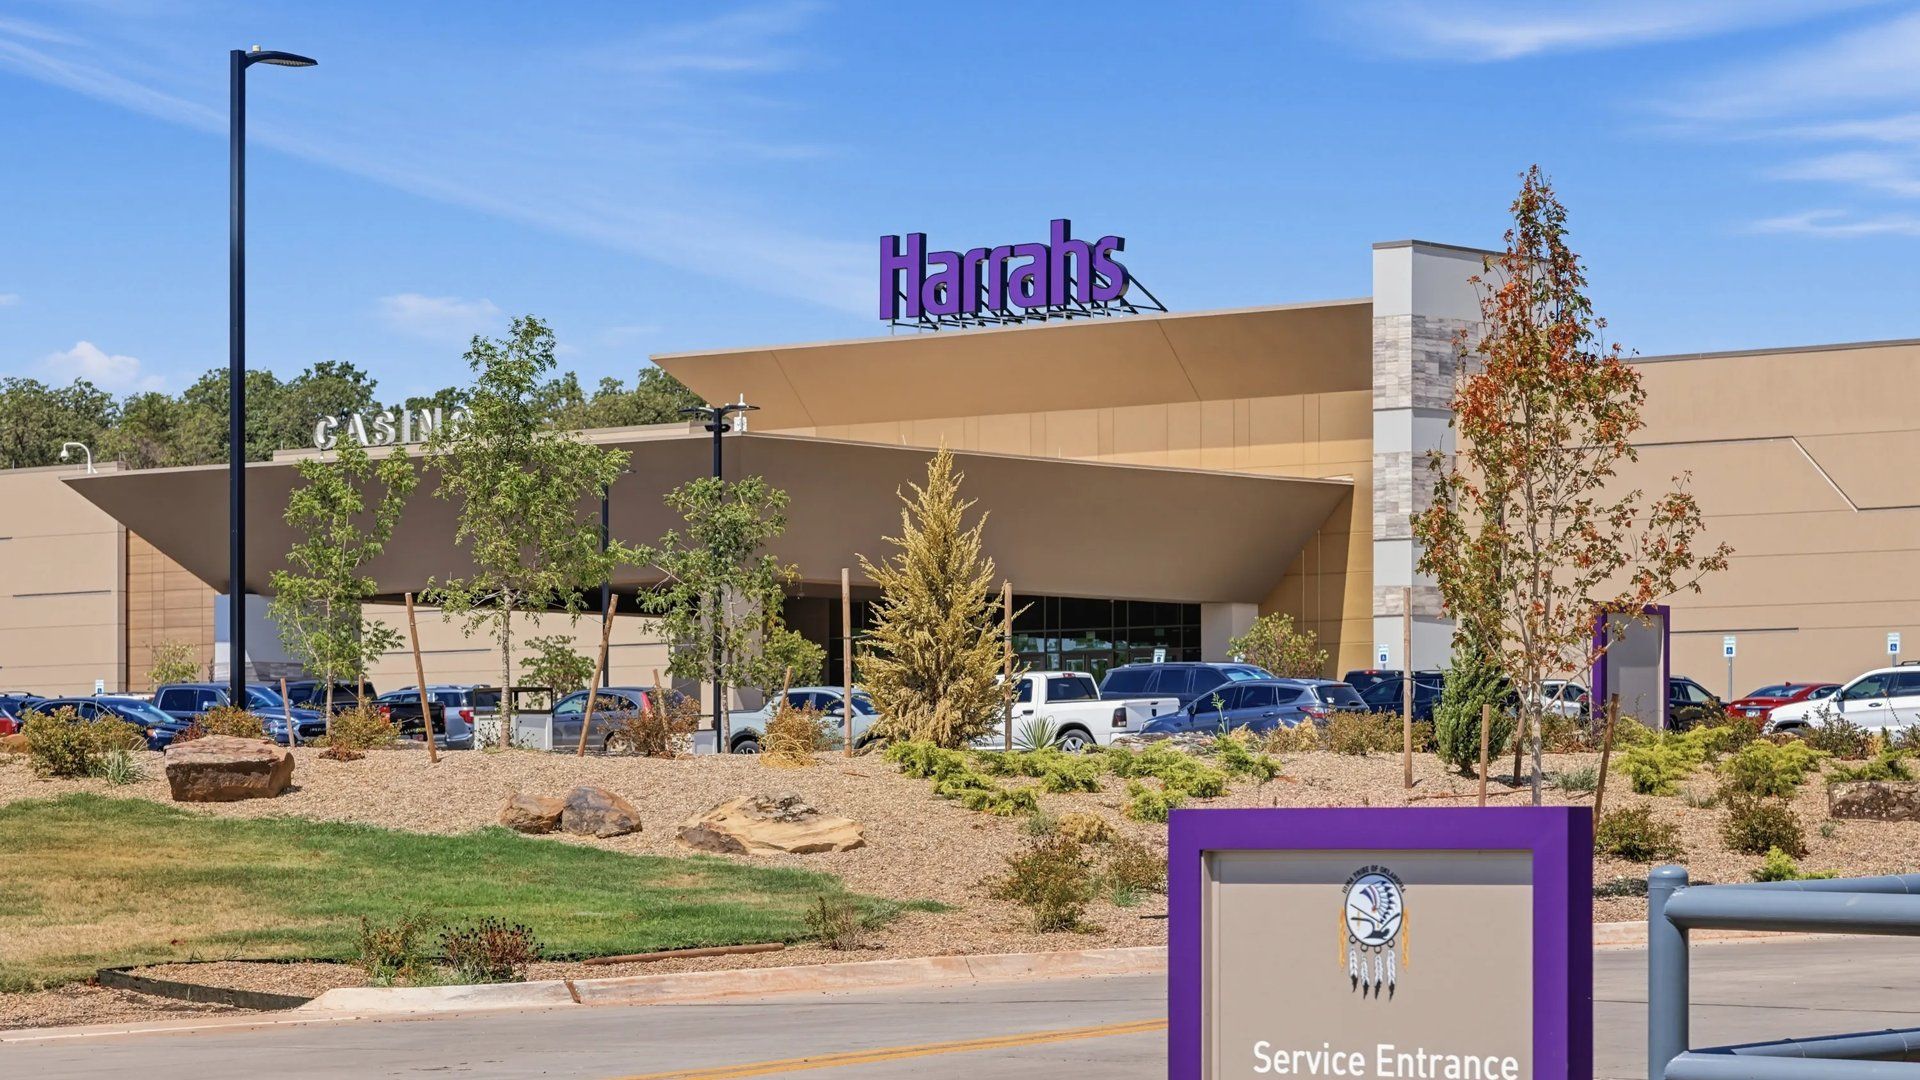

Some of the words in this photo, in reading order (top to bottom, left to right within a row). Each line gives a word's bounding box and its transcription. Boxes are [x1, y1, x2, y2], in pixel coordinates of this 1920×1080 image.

[879, 218, 1129, 320] Harrahs
[1253, 1040, 1366, 1076] Service
[1375, 1043, 1520, 1080] Entrance
